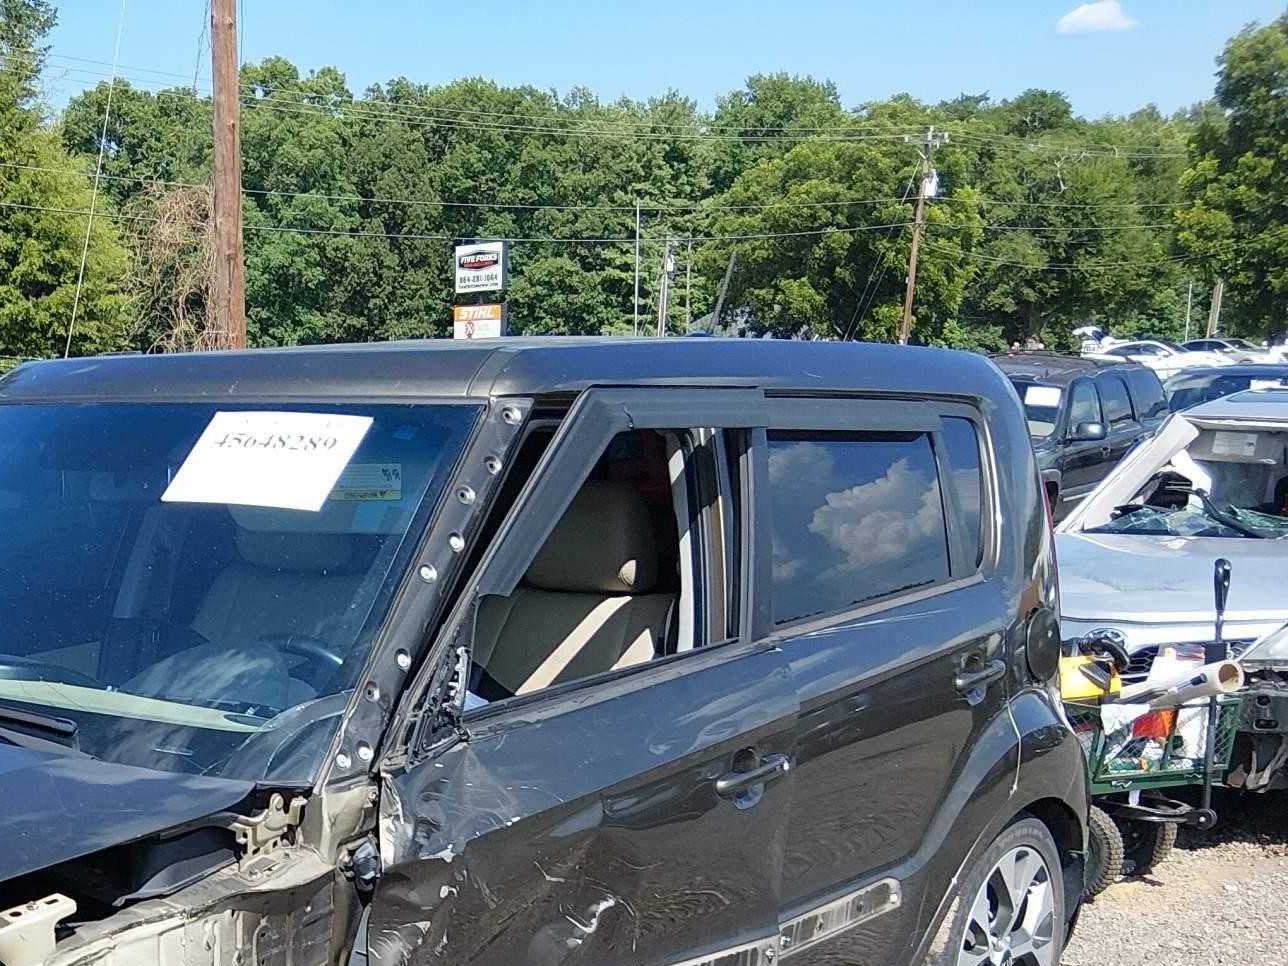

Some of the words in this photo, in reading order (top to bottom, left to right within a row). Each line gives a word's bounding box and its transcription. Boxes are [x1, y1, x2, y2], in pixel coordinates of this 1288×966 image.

[460, 255, 475, 264] FIVE
[475, 253, 498, 263] FORKS
[459, 305, 495, 320] STIHL
